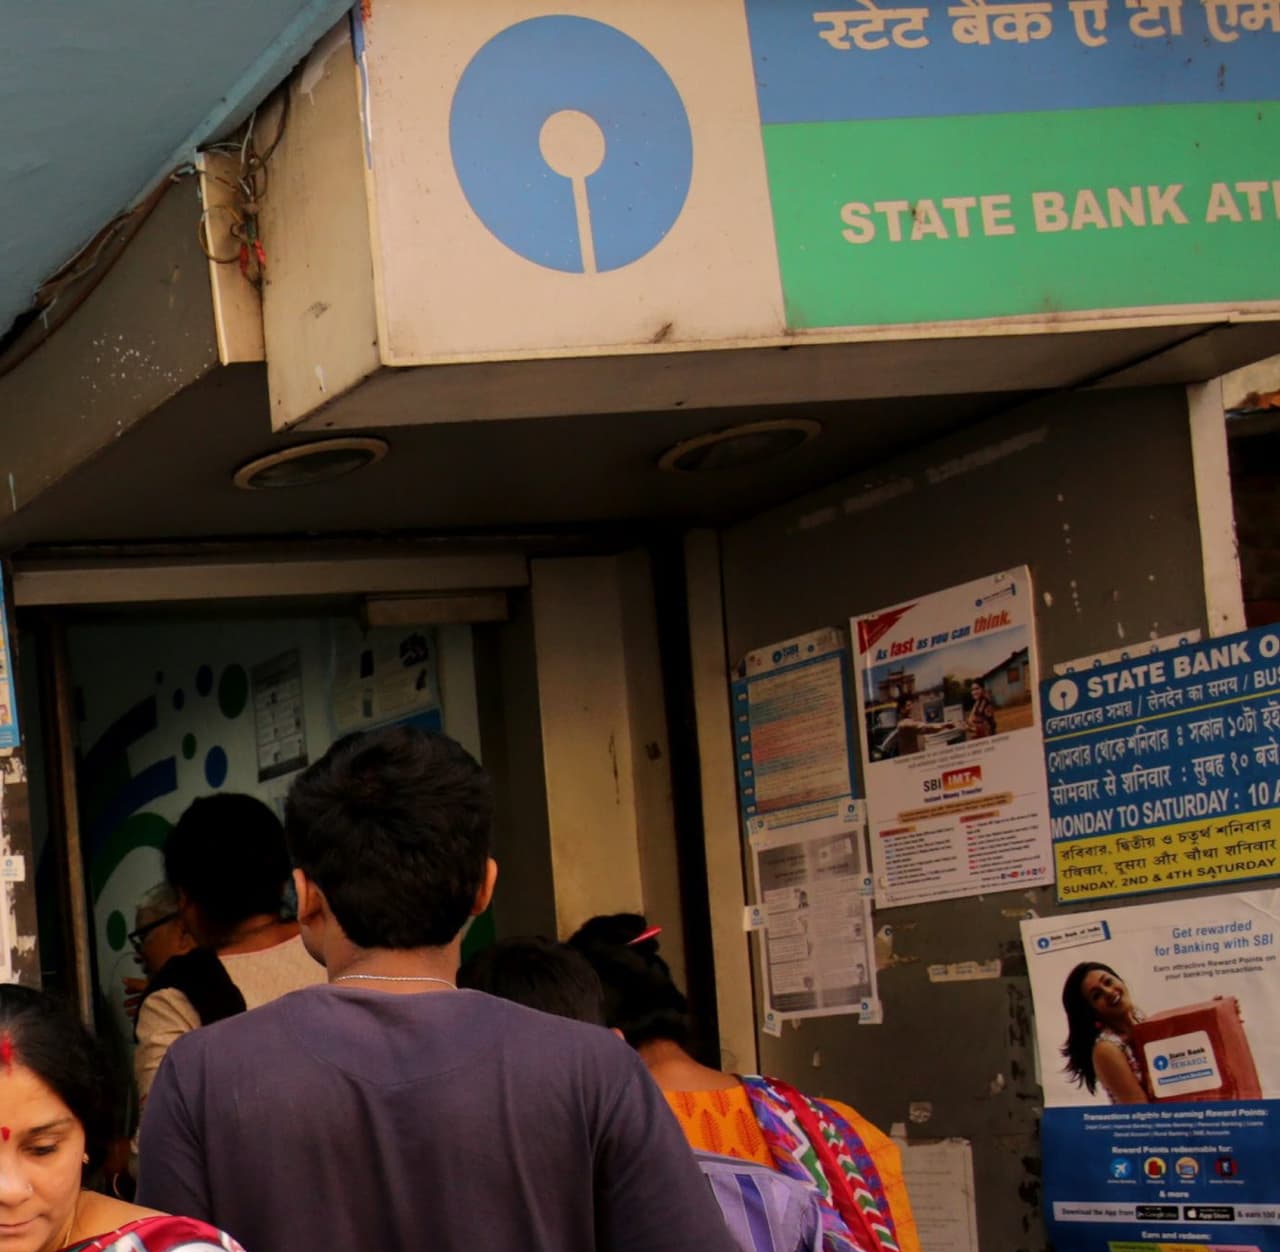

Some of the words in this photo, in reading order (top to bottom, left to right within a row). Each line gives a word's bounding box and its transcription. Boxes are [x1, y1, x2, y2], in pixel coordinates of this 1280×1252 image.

[1069, 0, 1108, 47] ए
[840, 194, 1017, 245] STATE
[1031, 183, 1189, 233] BANK
[890, 638, 914, 657] fast
[917, 639, 927, 650] as
[931, 632, 948, 647] you
[952, 626, 970, 639] can
[974, 611, 1011, 634] think.
[1088, 660, 1165, 698] STATE
[1173, 641, 1251, 678] BANK
[1187, 684, 1203, 700] का
[1206, 677, 1238, 697] समय
[923, 779, 941, 792] SBI
[1050, 778, 1100, 806] सोमवार
[1102, 769, 1117, 797] से
[1121, 763, 1172, 794] शनिवार
[1191, 753, 1226, 786] सुबह
[1051, 807, 1114, 840] MONDAY
[1116, 804, 1140, 829] TO
[1247, 781, 1270, 806] 10
[1224, 839, 1277, 857] शनिवार
[1122, 875, 1149, 887] 2ND
[1152, 873, 1162, 882] &
[1166, 869, 1193, 881] 4TH
[1196, 857, 1277, 877] SATURDAY
[1154, 945, 1170, 956] for
[1174, 940, 1219, 956] Banking
[1224, 937, 1249, 951] with
[1253, 933, 1274, 947] SBI
[1172, 927, 1192, 939] Get
[1195, 920, 1252, 936] rewarded
